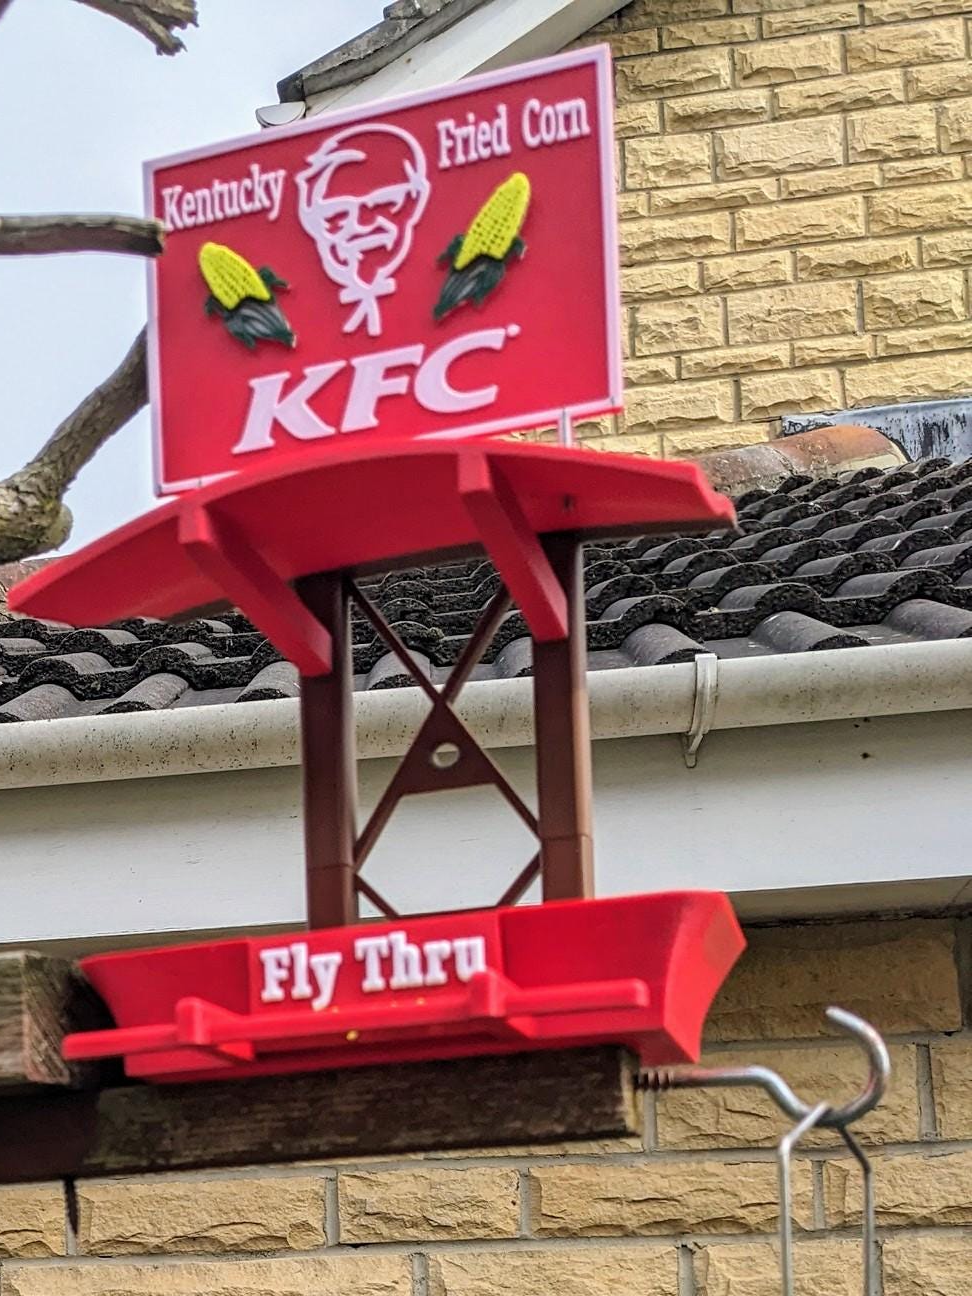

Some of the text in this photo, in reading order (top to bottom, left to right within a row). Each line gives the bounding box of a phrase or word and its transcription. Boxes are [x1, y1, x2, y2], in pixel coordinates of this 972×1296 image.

[160, 97, 590, 231] Kentucky Fried Corn
[232, 326, 508, 454] KFC
[259, 930, 486, 1011] Fly Thru
